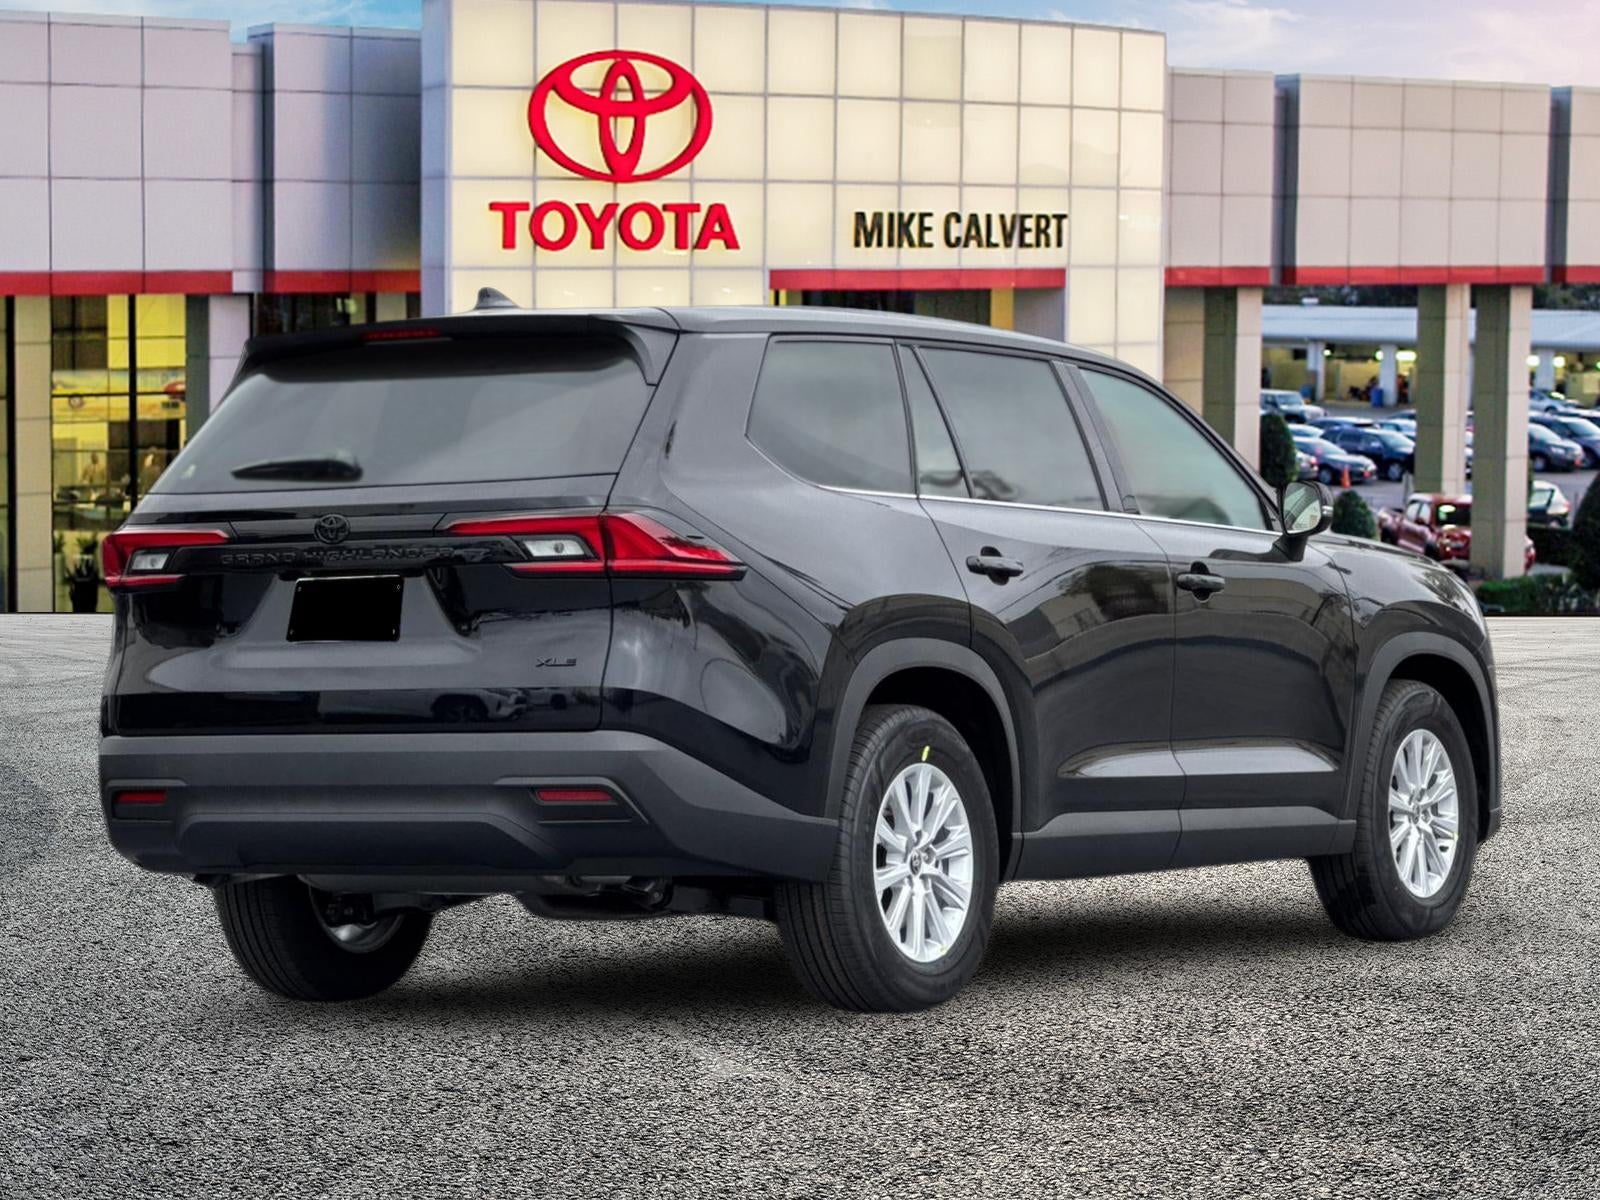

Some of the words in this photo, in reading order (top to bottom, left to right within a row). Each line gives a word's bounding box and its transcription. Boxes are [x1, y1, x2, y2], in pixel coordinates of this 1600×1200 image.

[489, 200, 740, 250] TOYOTA
[854, 211, 934, 248] MIKE
[943, 212, 1068, 248] CALVERT
[221, 552, 296, 566] GRAND
[302, 546, 455, 562] HIGHLANDER
[535, 657, 577, 668] XLE
